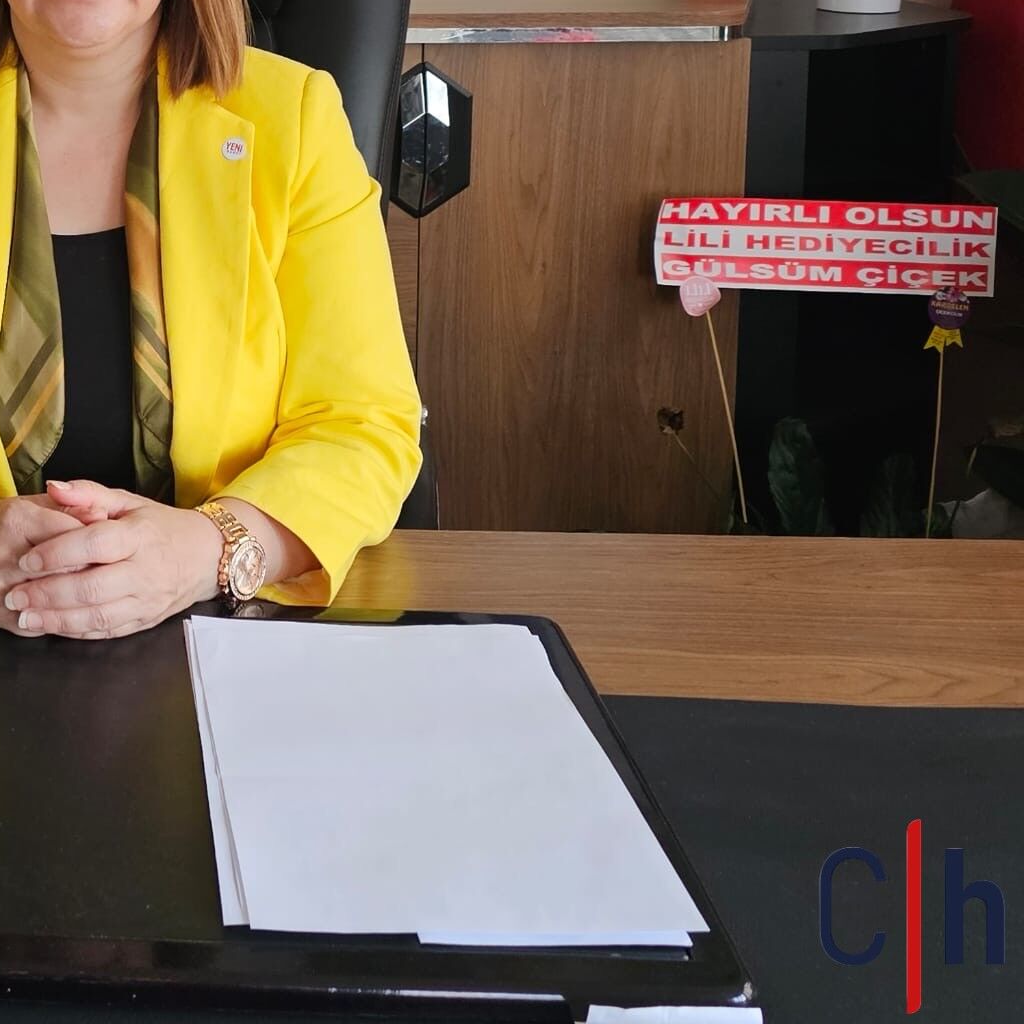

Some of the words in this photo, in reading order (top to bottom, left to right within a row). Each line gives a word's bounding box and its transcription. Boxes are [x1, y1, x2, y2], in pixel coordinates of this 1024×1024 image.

[662, 202, 830, 224] HAYIRLI
[845, 206, 993, 229] OLSUN
[663, 230, 730, 249] LİLİ
[746, 233, 991, 258] HEDİYECİLİK
[662, 258, 842, 283] GÜLSÜM
[857, 264, 989, 288] ÇİÇEK
